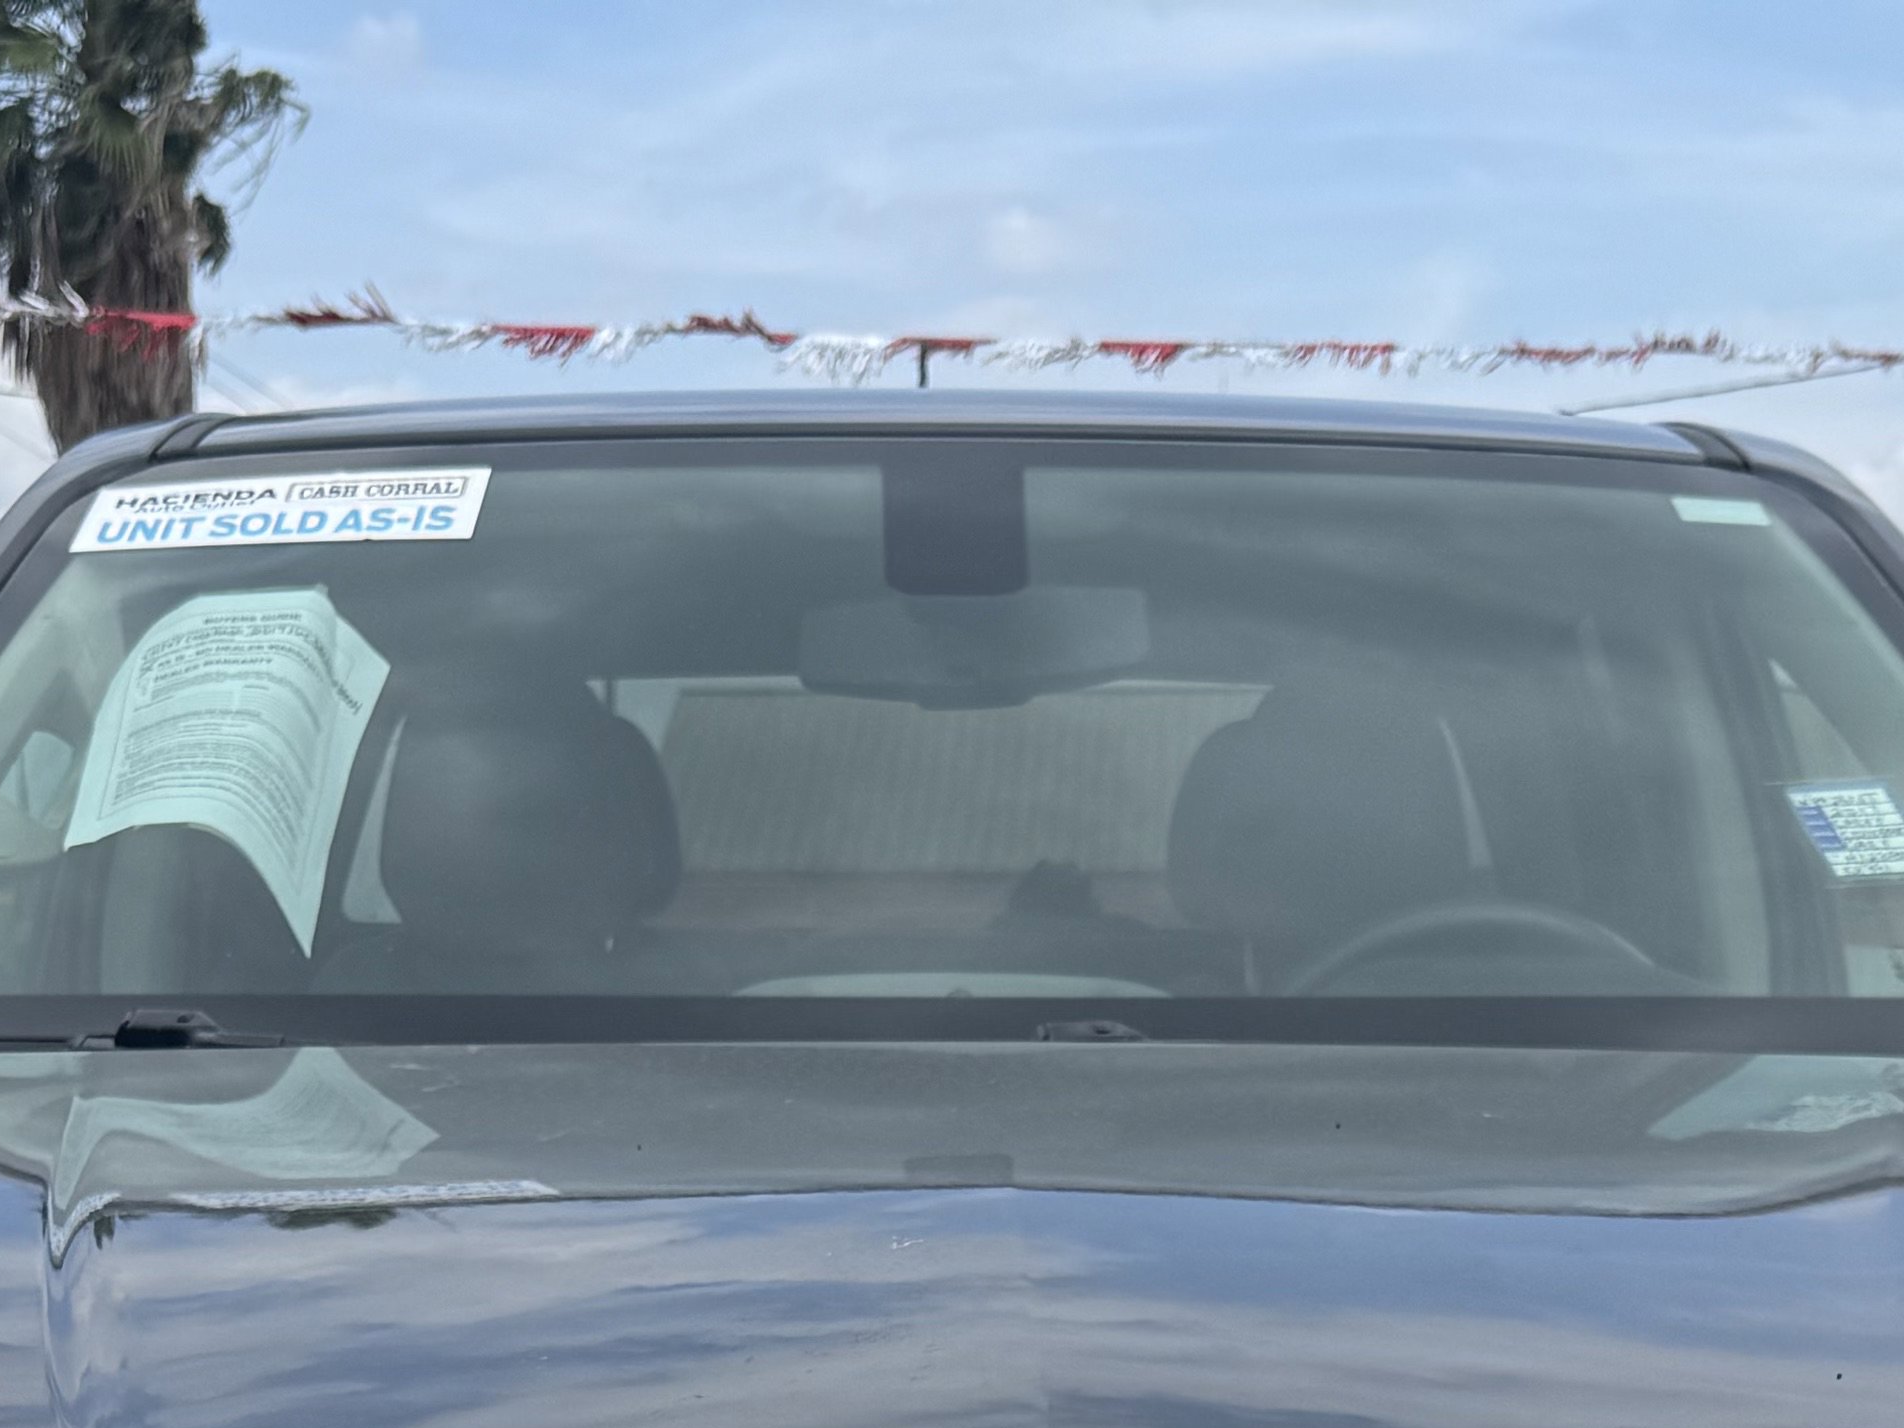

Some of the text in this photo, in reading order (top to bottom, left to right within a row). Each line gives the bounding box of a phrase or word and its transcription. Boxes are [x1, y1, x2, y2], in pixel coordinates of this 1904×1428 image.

[115, 488, 277, 509] HACIENDA
[299, 481, 460, 500] CASH CORRAL
[134, 499, 256, 513] Auto Outlet
[97, 505, 458, 543] UNIT SOLD AS-IS
